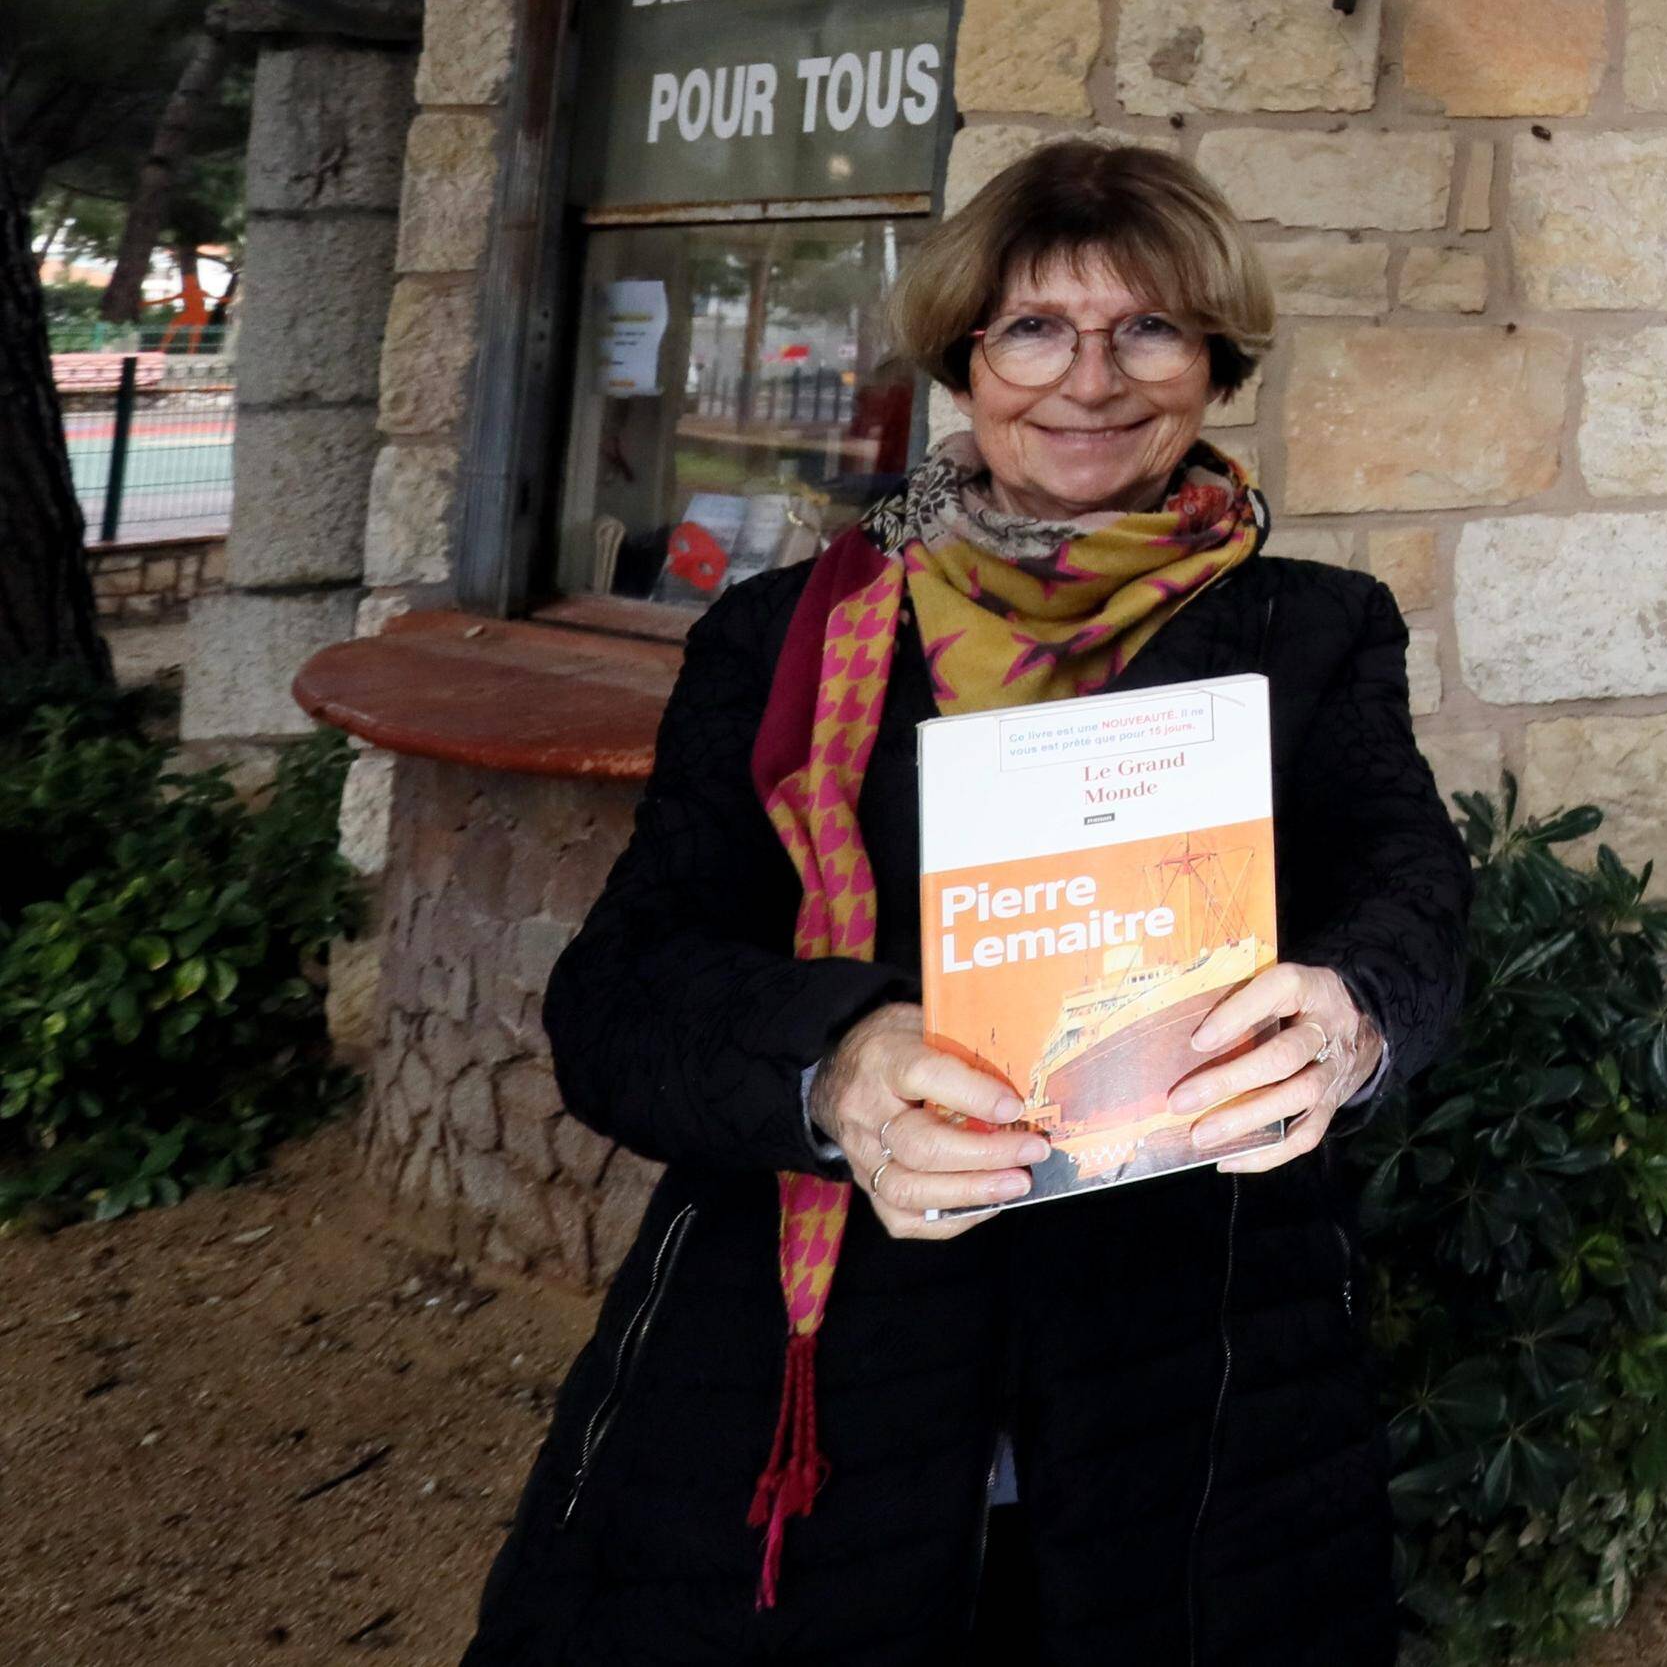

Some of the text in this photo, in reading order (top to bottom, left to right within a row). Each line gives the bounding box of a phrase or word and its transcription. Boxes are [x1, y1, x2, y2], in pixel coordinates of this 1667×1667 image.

[647, 42, 940, 144] POUR TOUS
[1009, 733, 1024, 743] Ce
[1028, 728, 1053, 741] livre
[1056, 725, 1074, 736] est
[1078, 722, 1099, 733] une
[1191, 707, 1204, 717] ne
[1009, 745, 1037, 757] vous
[1041, 742, 1059, 752] est
[1095, 734, 1116, 747] que
[1119, 730, 1146, 743] pour
[1083, 751, 1186, 782] Le Grand
[1085, 781, 1158, 805] Monde
[941, 875, 1097, 928] Pierre
[942, 906, 1176, 975] Lemaitre
